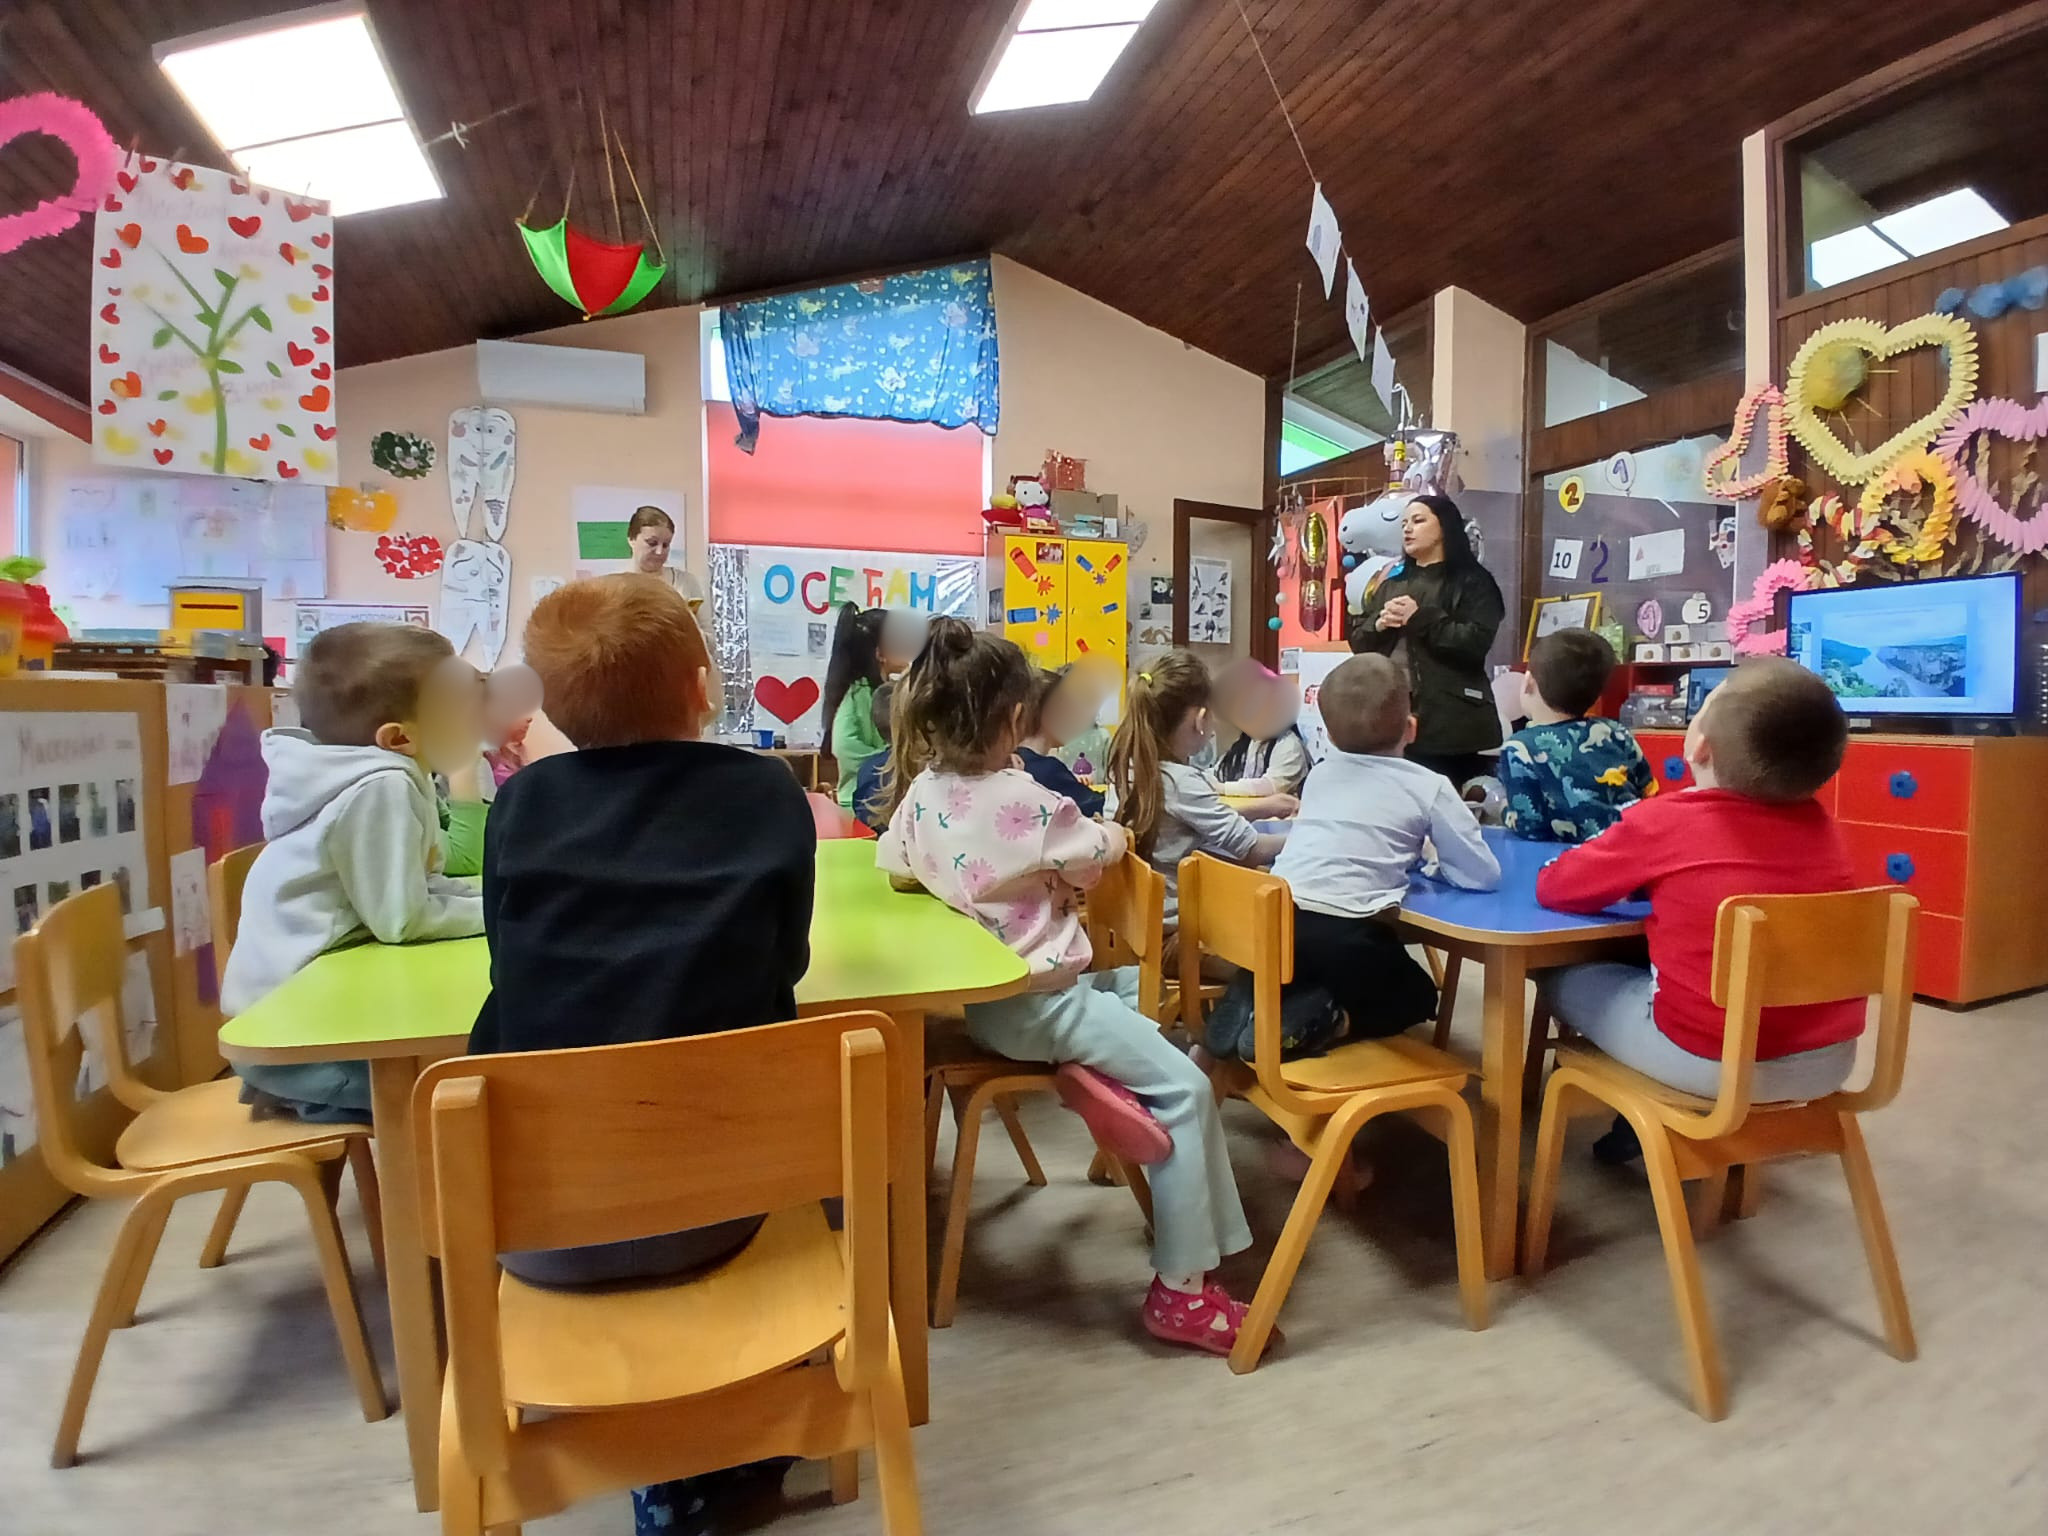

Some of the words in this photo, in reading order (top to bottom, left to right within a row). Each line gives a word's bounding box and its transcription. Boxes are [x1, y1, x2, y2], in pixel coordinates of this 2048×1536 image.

[1565, 482, 1579, 506] 2
[1553, 552, 1572, 569] 10
[1590, 541, 1609, 583] 2
[764, 564, 937, 615] ОСЕЋАМ
[1697, 603, 1709, 619] 5
